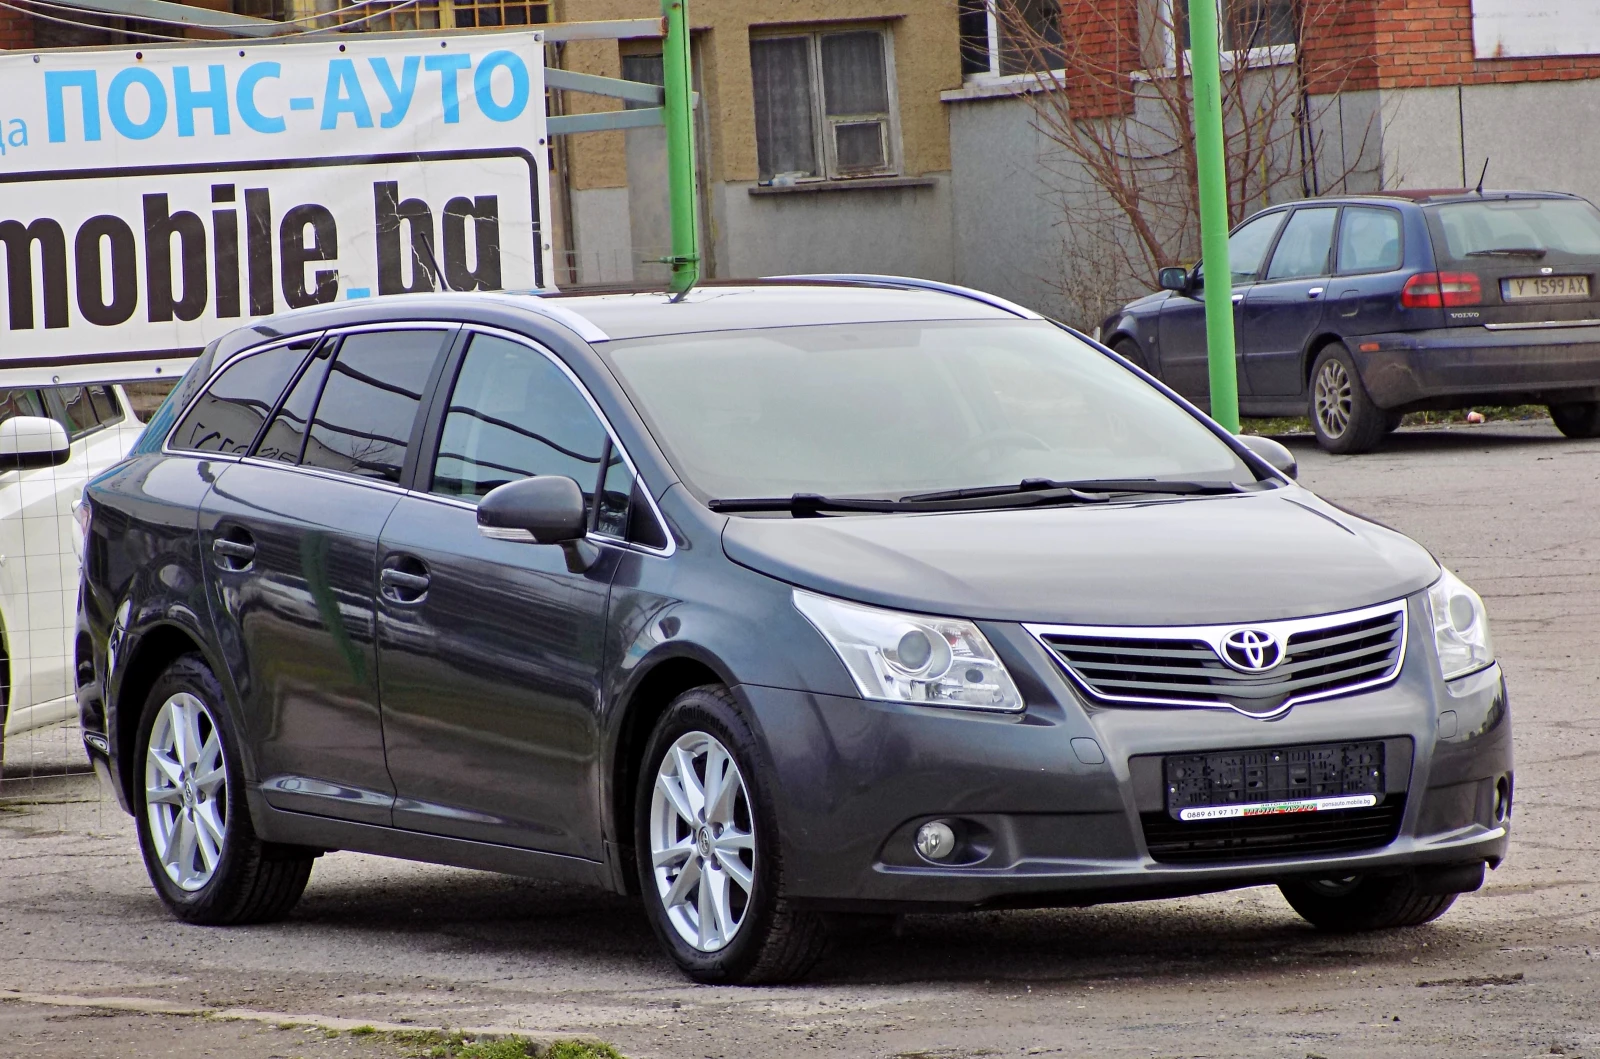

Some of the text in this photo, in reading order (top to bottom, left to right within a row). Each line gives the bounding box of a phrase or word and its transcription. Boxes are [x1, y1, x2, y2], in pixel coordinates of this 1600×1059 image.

[44, 49, 531, 144] ПОНС-АУТО
[1533, 279, 1565, 295] 1599
[1568, 277, 1585, 293] AX
[1321, 799, 1371, 808] ponsauto.mobile.bg
[1186, 811, 1206, 819] 0889
